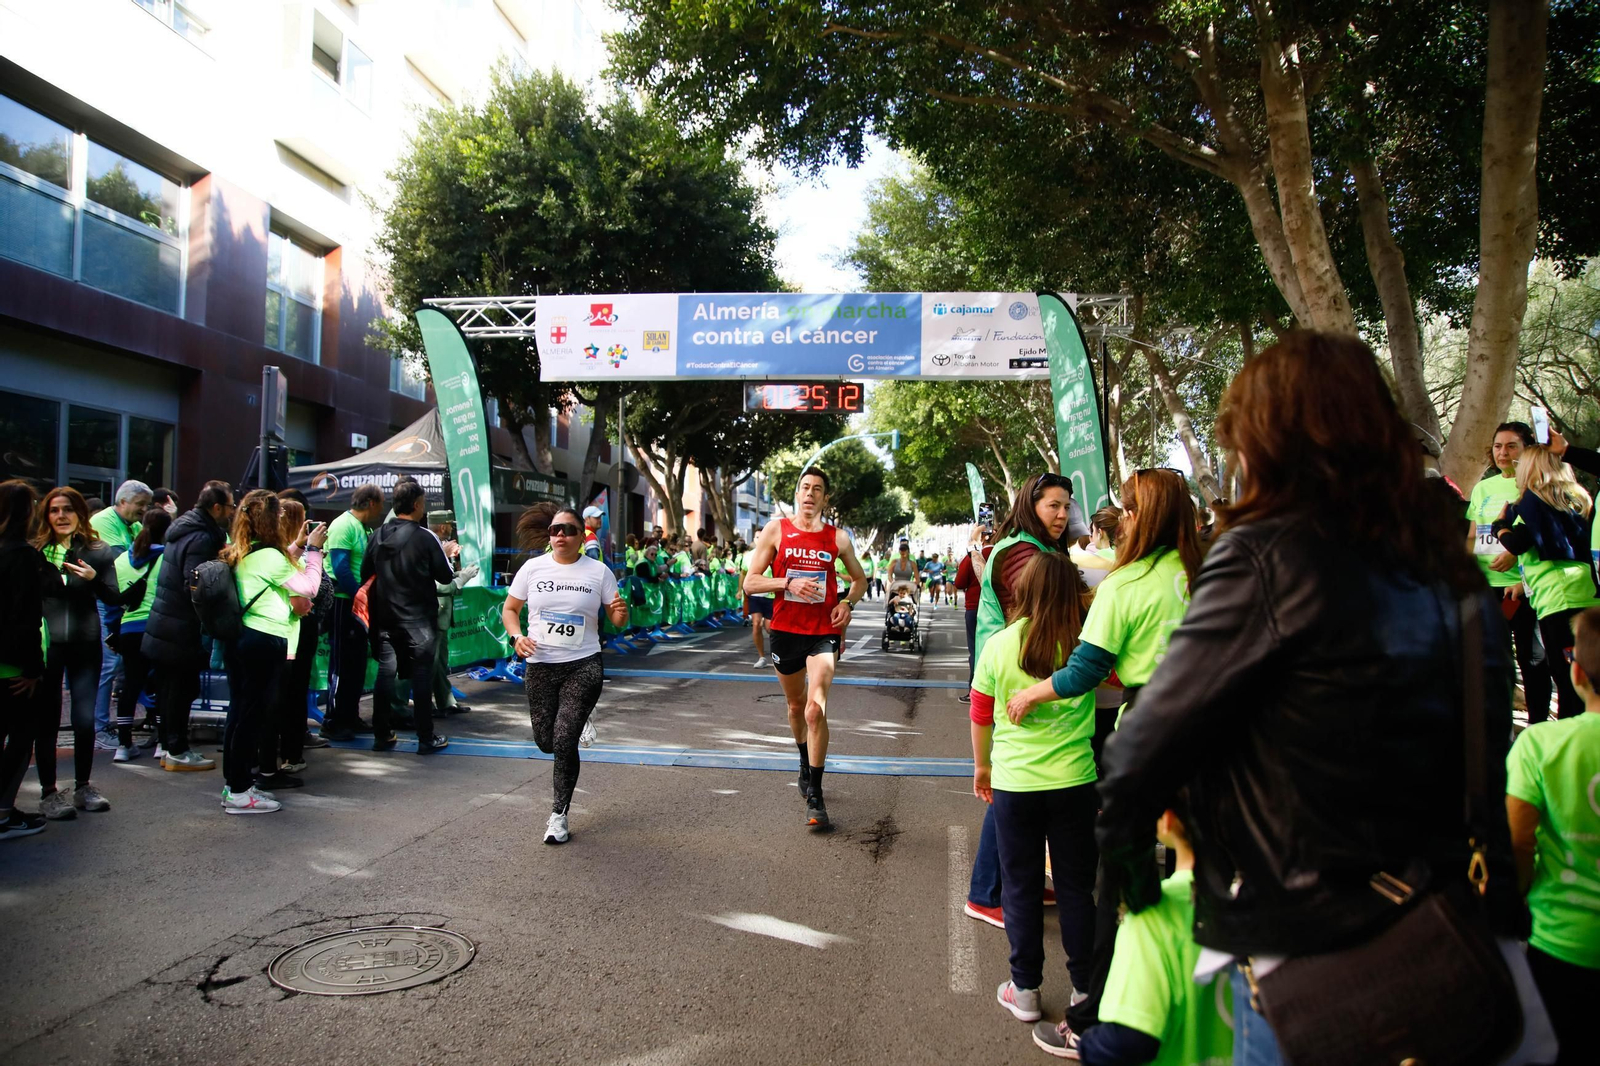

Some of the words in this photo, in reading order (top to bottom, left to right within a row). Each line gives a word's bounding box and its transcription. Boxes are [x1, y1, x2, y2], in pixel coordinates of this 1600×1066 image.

[693, 302, 779, 320] Almería
[787, 305, 813, 319] en
[822, 301, 907, 319] marcha
[950, 304, 995, 316] cajamar
[692, 327, 765, 345] contra
[771, 326, 793, 344] el
[799, 326, 878, 344] cáncer
[992, 331, 1045, 341] Fundación
[541, 347, 573, 356] ALMERÍA
[954, 353, 976, 361] Toyota
[1019, 348, 1037, 356] Ejido
[686, 361, 758, 370] #TodosContraElCáncer
[341, 472, 443, 488] cruzandometa
[785, 548, 832, 562] PULSO
[556, 584, 593, 594] primaflor
[547, 623, 576, 636] 749
